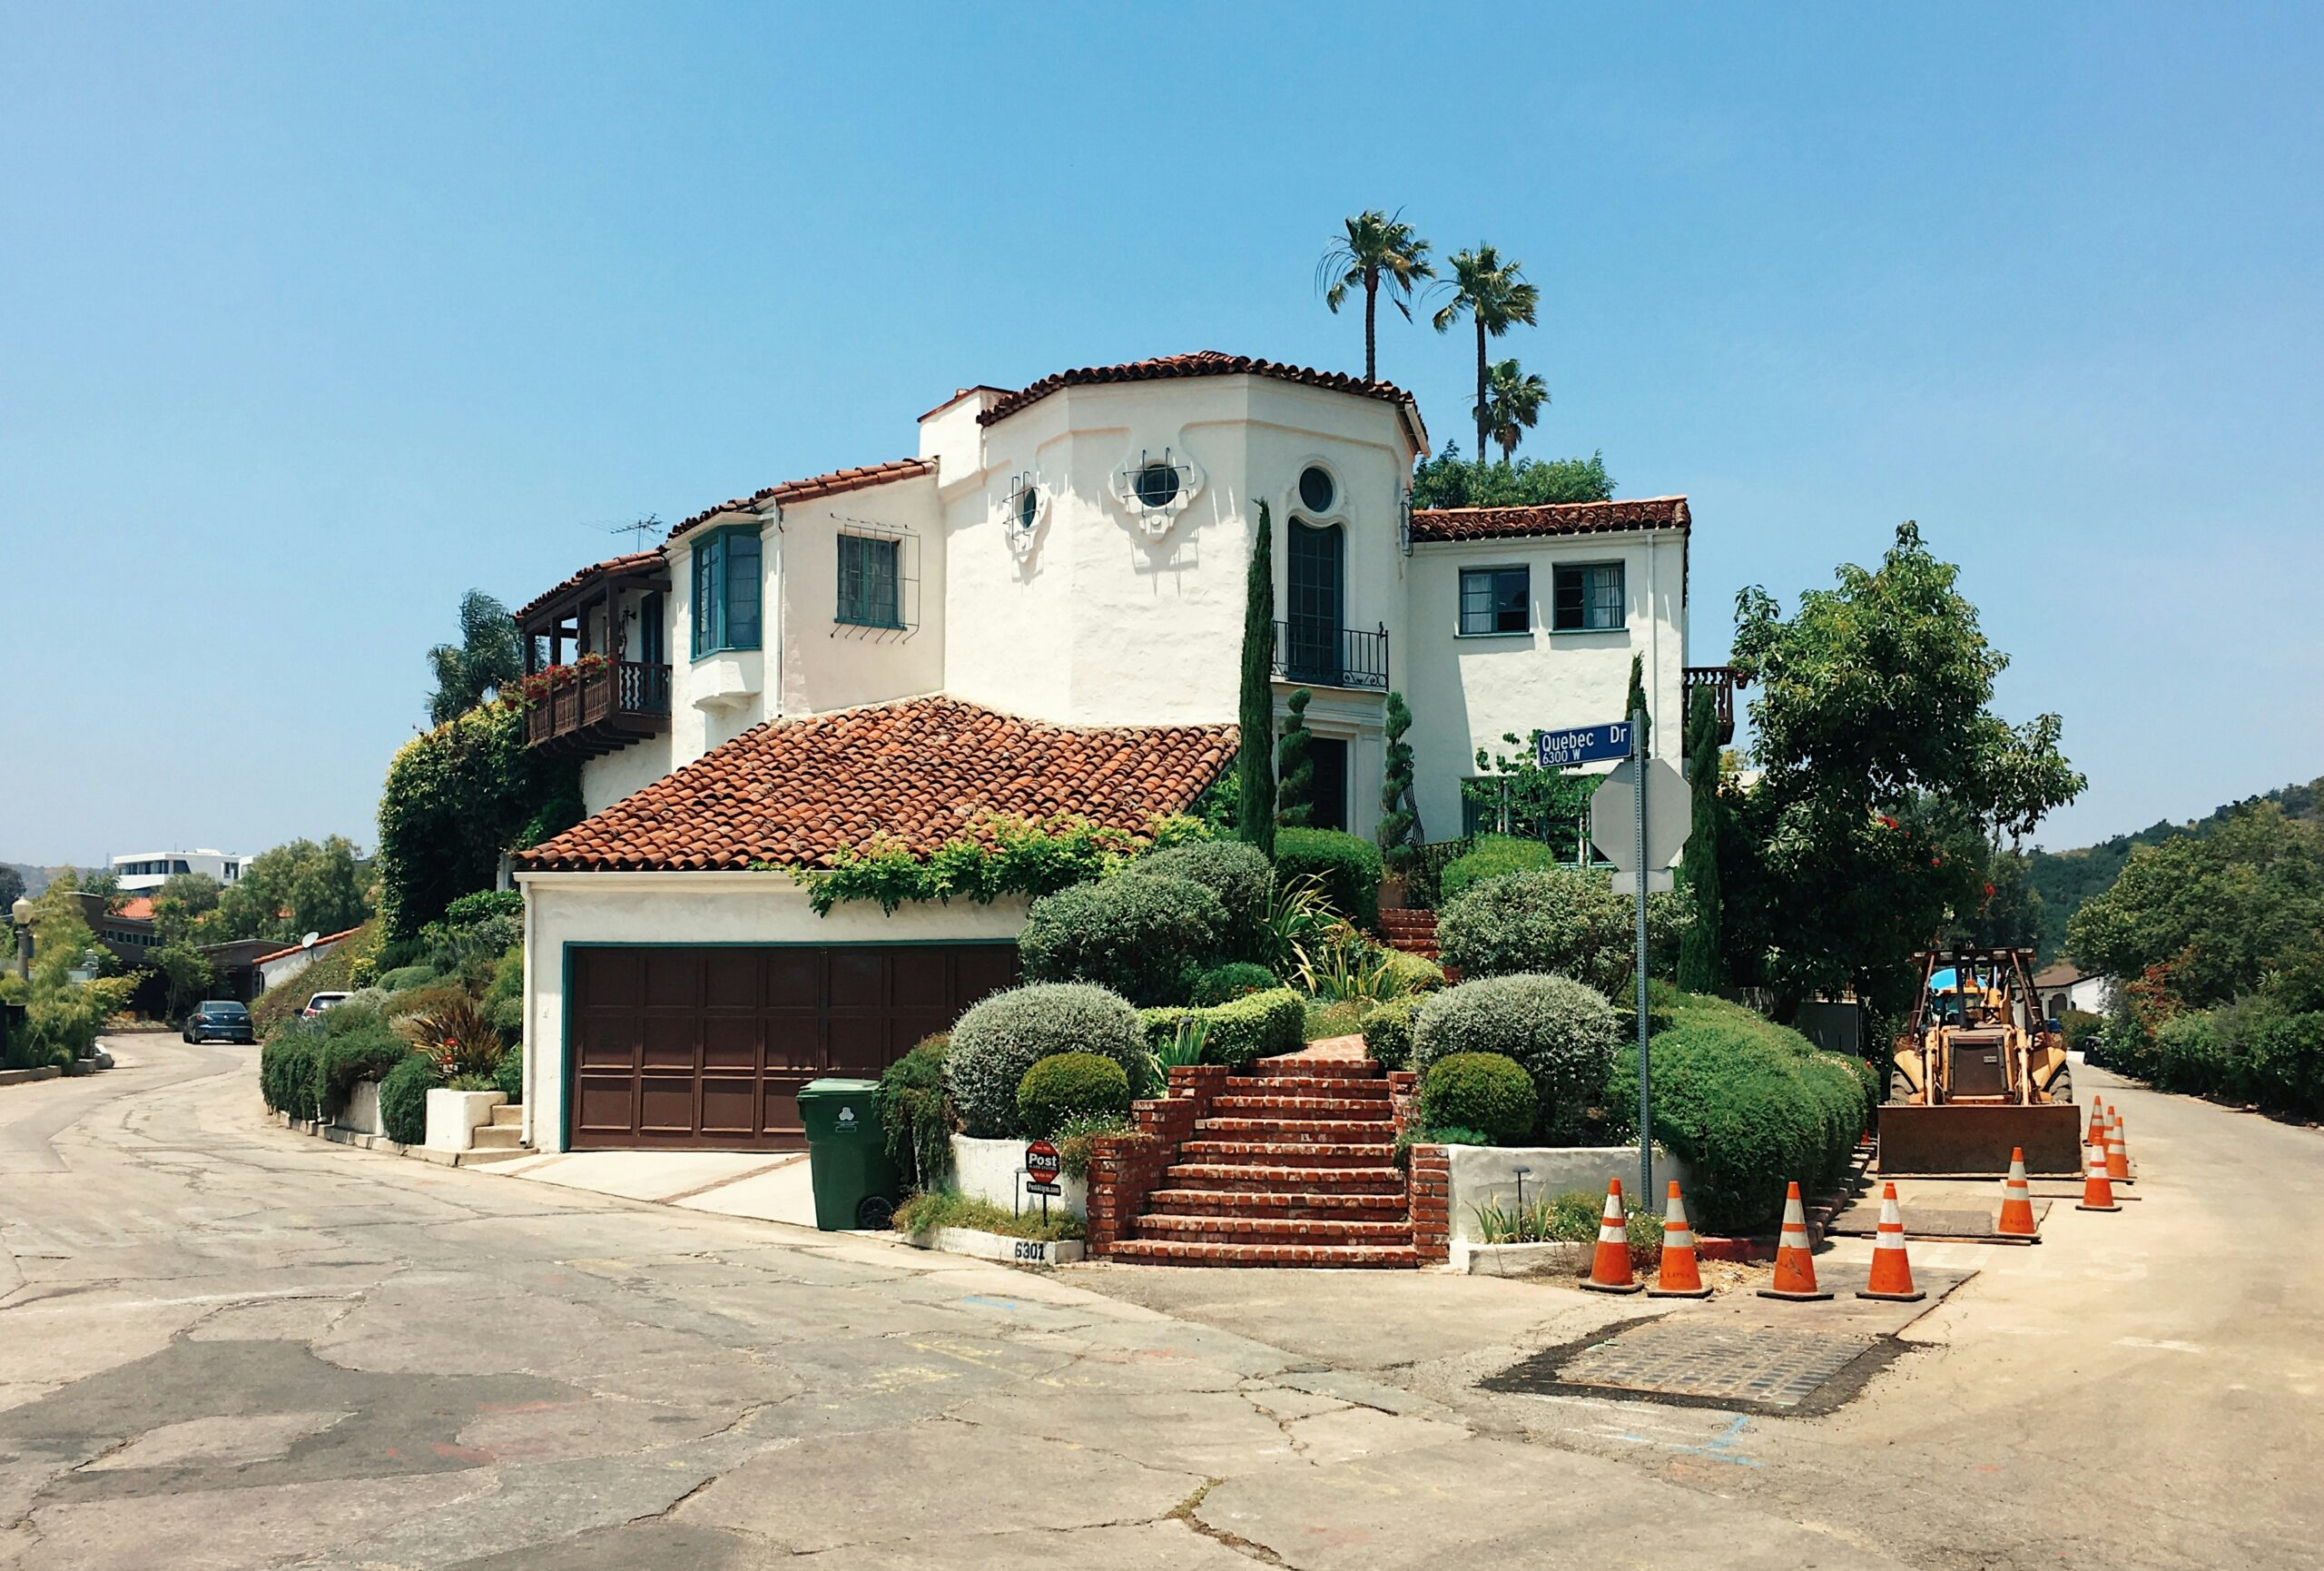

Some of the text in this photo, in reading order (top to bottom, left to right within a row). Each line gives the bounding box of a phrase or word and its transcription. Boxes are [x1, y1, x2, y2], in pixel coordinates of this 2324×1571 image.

[1541, 726, 1628, 753] Quebec Dr
[1542, 747, 1581, 765] 6300 W
[1029, 1152, 1058, 1167] Post
[1014, 1240, 1046, 1260] 6301
